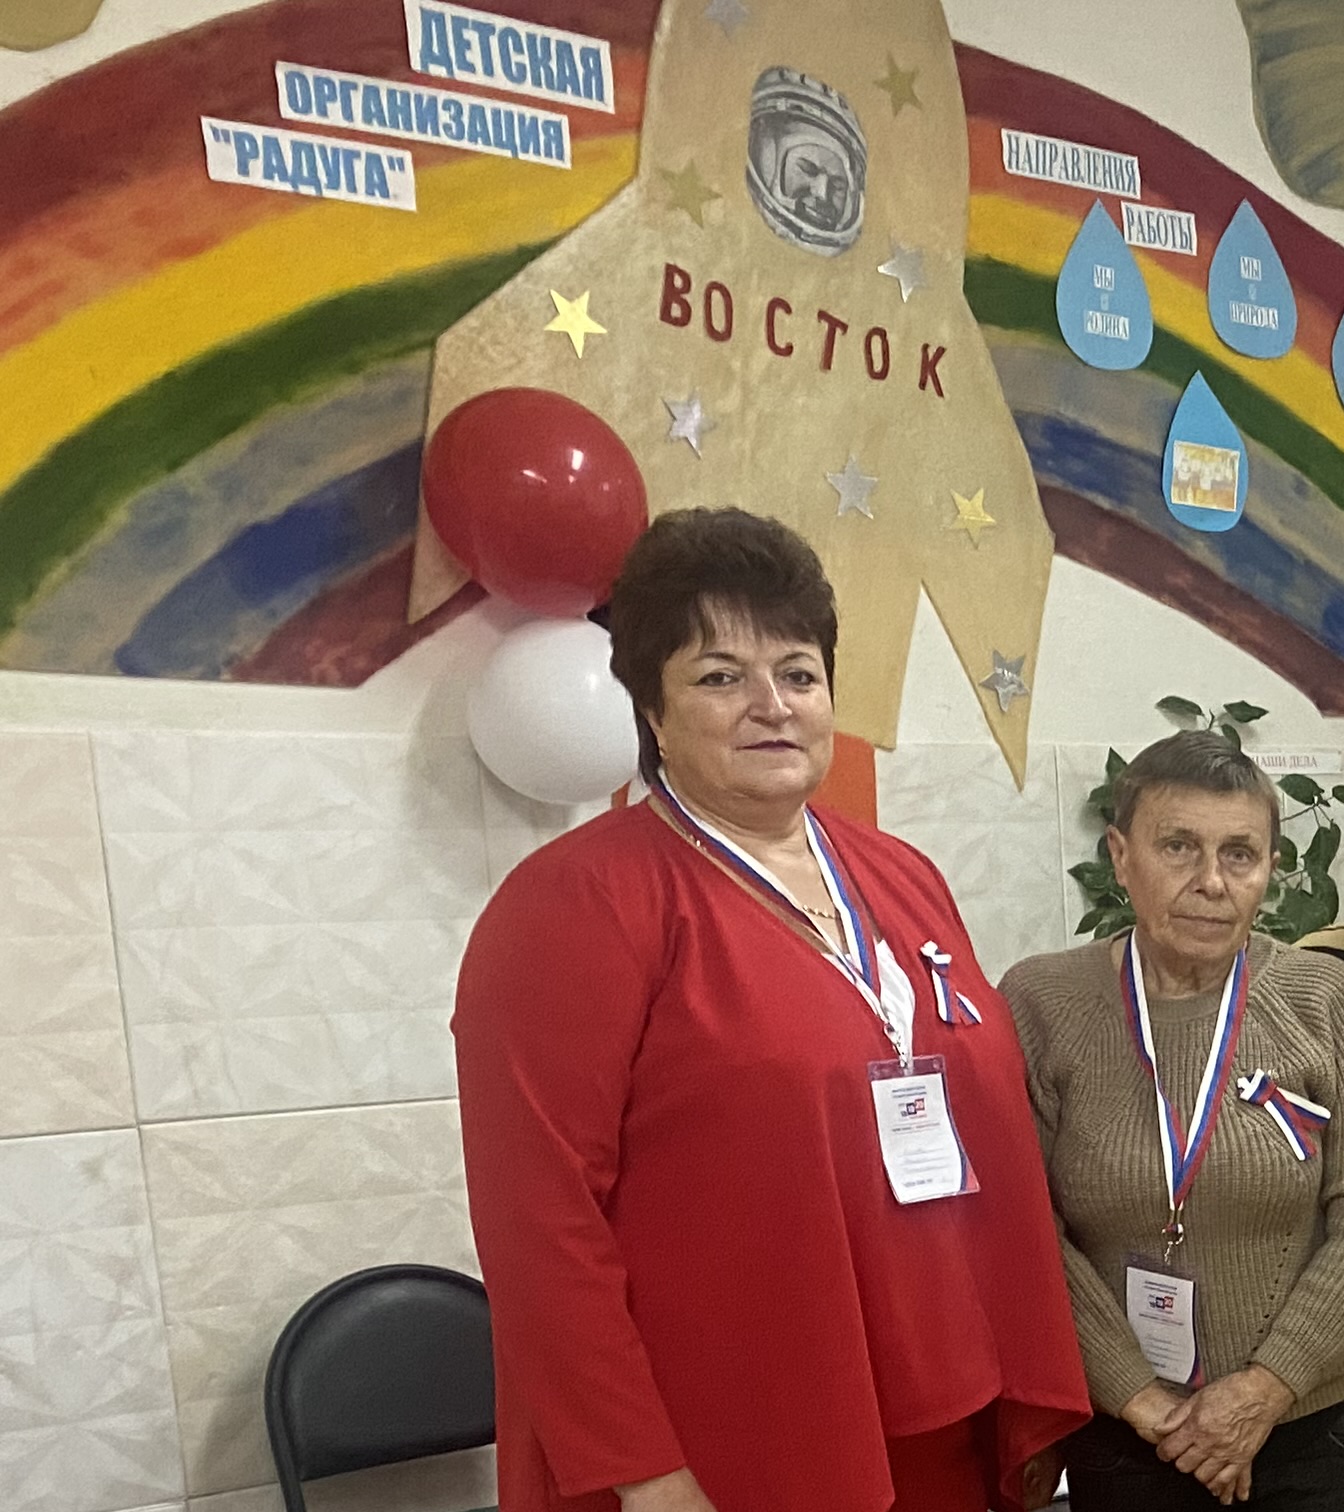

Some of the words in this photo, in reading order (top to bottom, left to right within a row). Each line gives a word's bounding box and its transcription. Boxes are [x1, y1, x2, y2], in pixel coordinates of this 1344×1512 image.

[418, 8, 608, 103] ДЕТСКАЯ
[284, 69, 566, 162] ОРГАНИЗАЦИЯ
[211, 126, 406, 200] "РАДУГА"
[1006, 132, 1138, 196] НАПРАВЛЕНИЯ
[1125, 204, 1194, 253] РАБОТЫ
[1094, 265, 1114, 289] МЫ
[1242, 257, 1261, 281] МЫ
[659, 262, 947, 399] ВОСТОК
